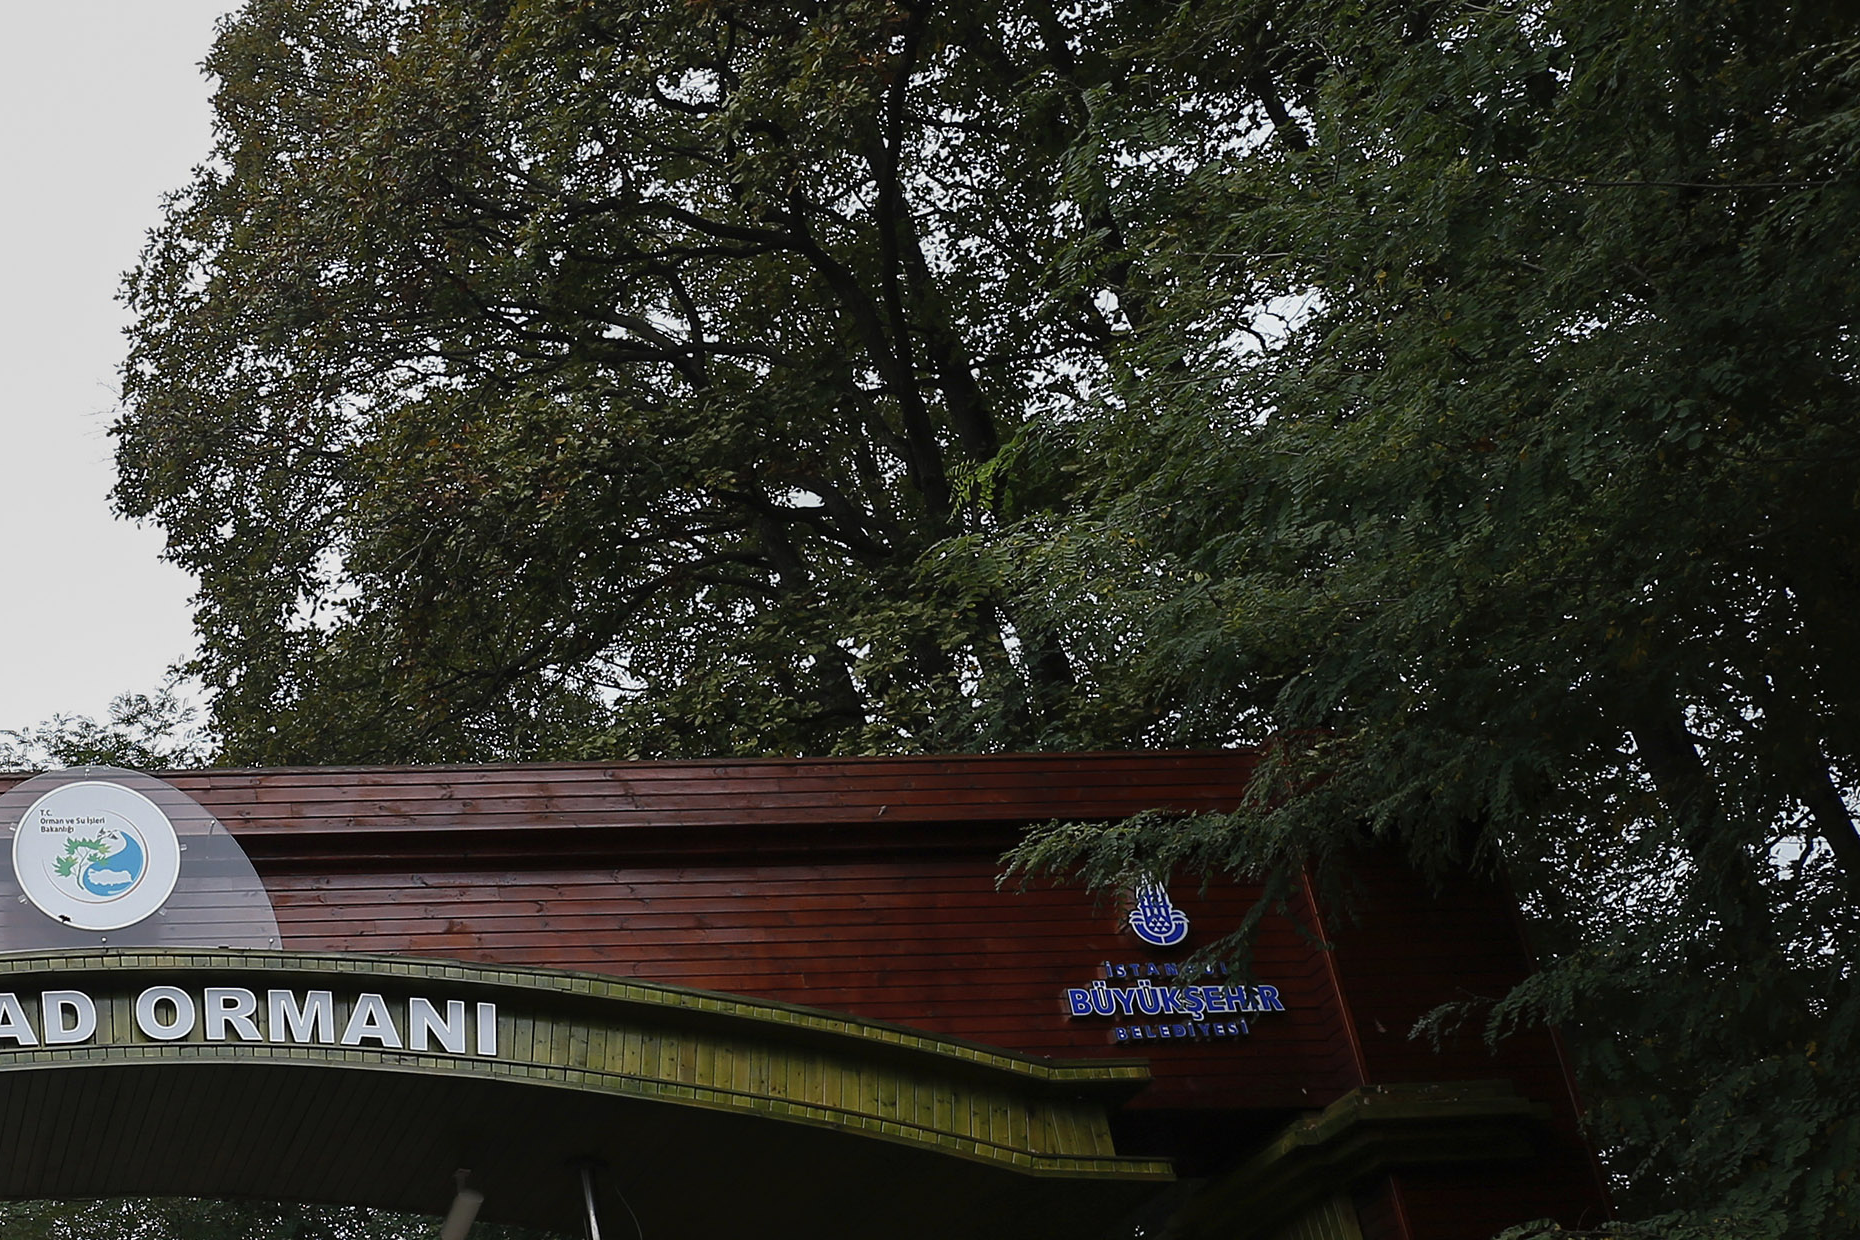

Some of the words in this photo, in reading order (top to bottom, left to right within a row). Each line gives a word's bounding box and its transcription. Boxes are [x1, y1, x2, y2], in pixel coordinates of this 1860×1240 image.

[86, 816, 105, 825] İşleri
[134, 984, 500, 1058] ORMANI
[1114, 1019, 1249, 1041] BELEDİYESİ
